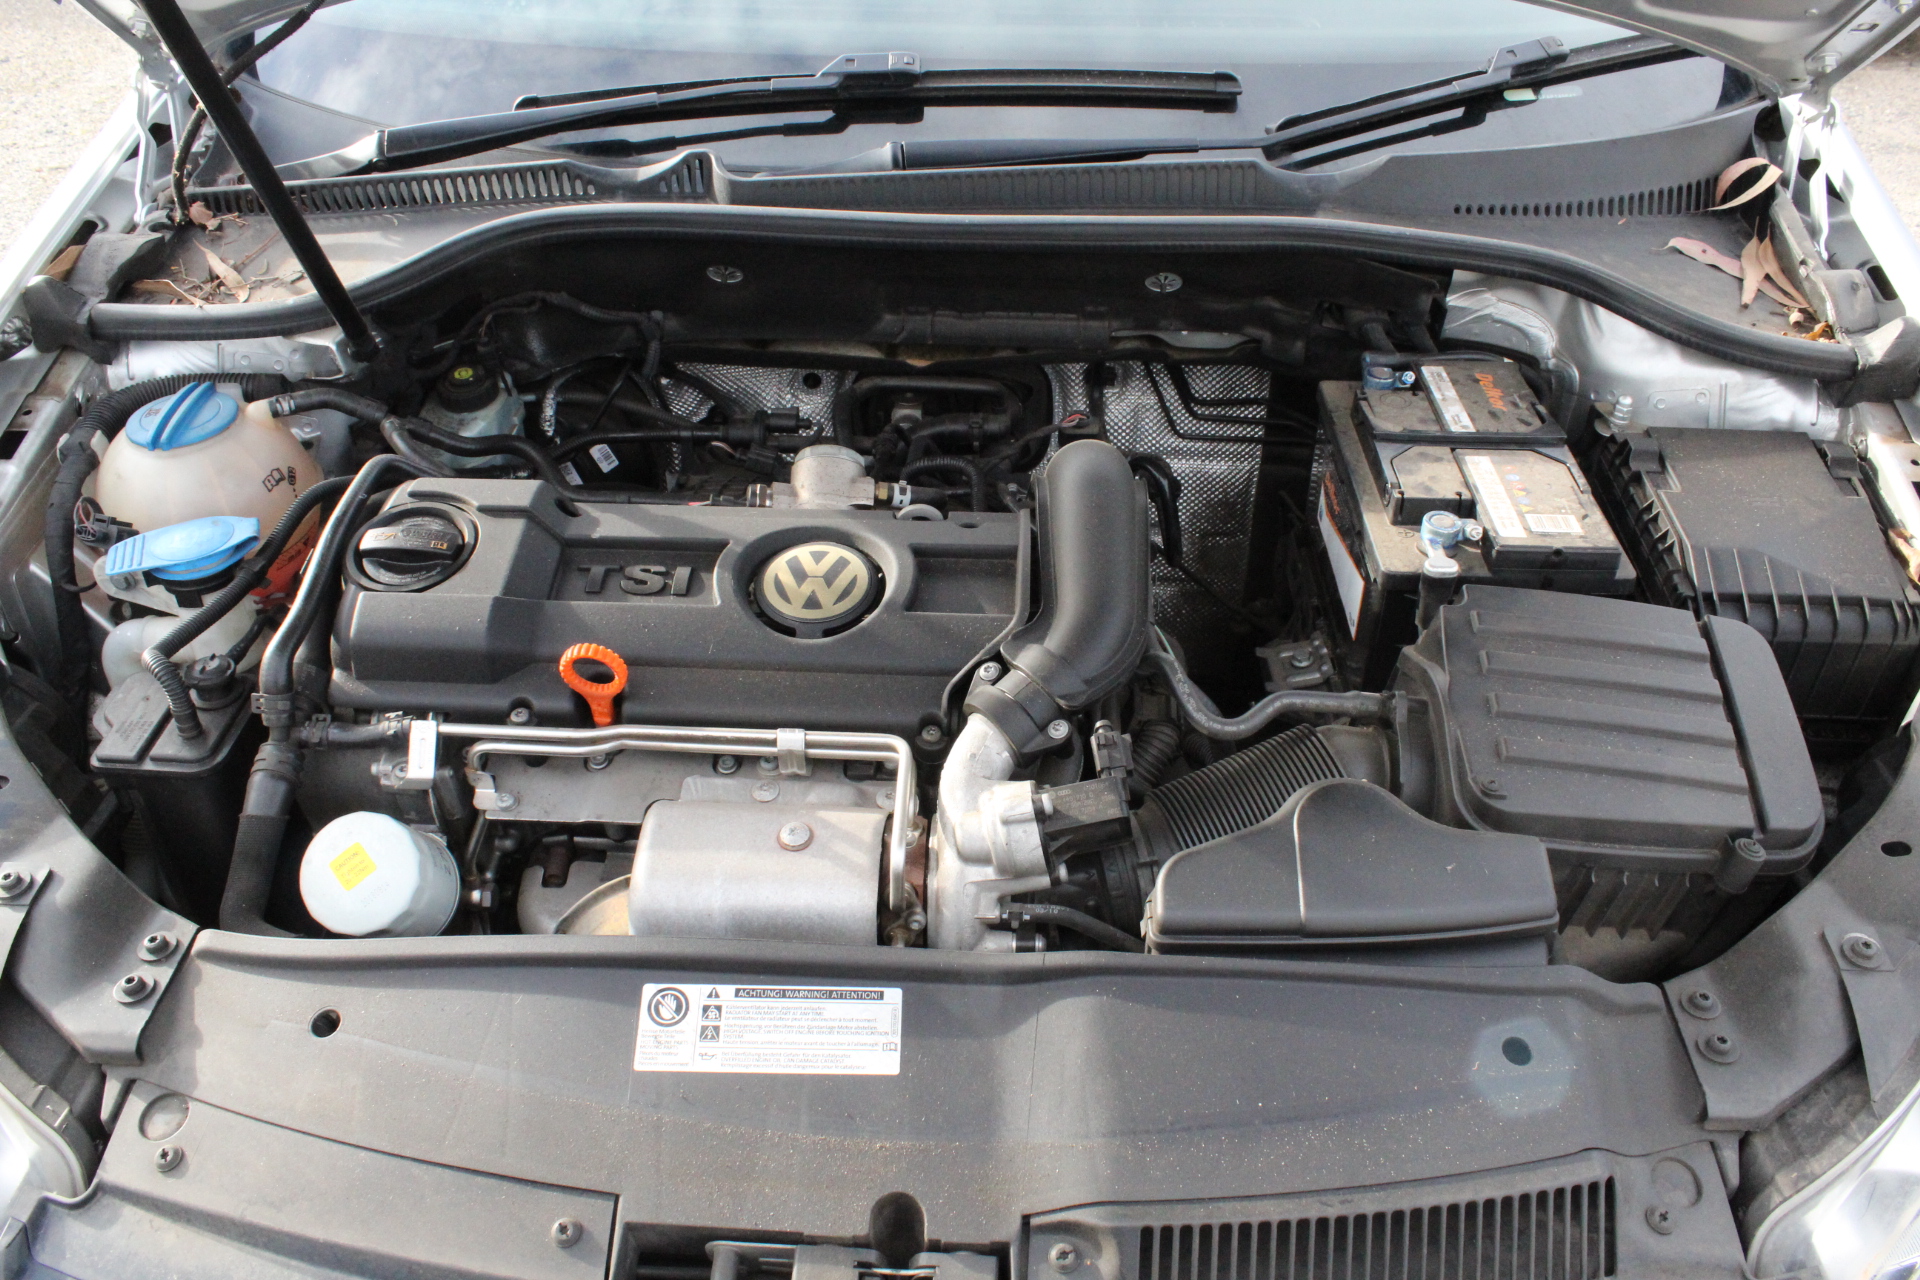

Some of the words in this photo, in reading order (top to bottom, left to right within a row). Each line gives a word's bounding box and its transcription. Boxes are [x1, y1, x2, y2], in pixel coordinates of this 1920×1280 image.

[1474, 373, 1508, 411] Delkor
[578, 565, 693, 596] TSI
[738, 989, 782, 998] ACHTUNG!
[785, 990, 829, 999] WARNING!
[832, 991, 881, 1000] ATTENTION!
